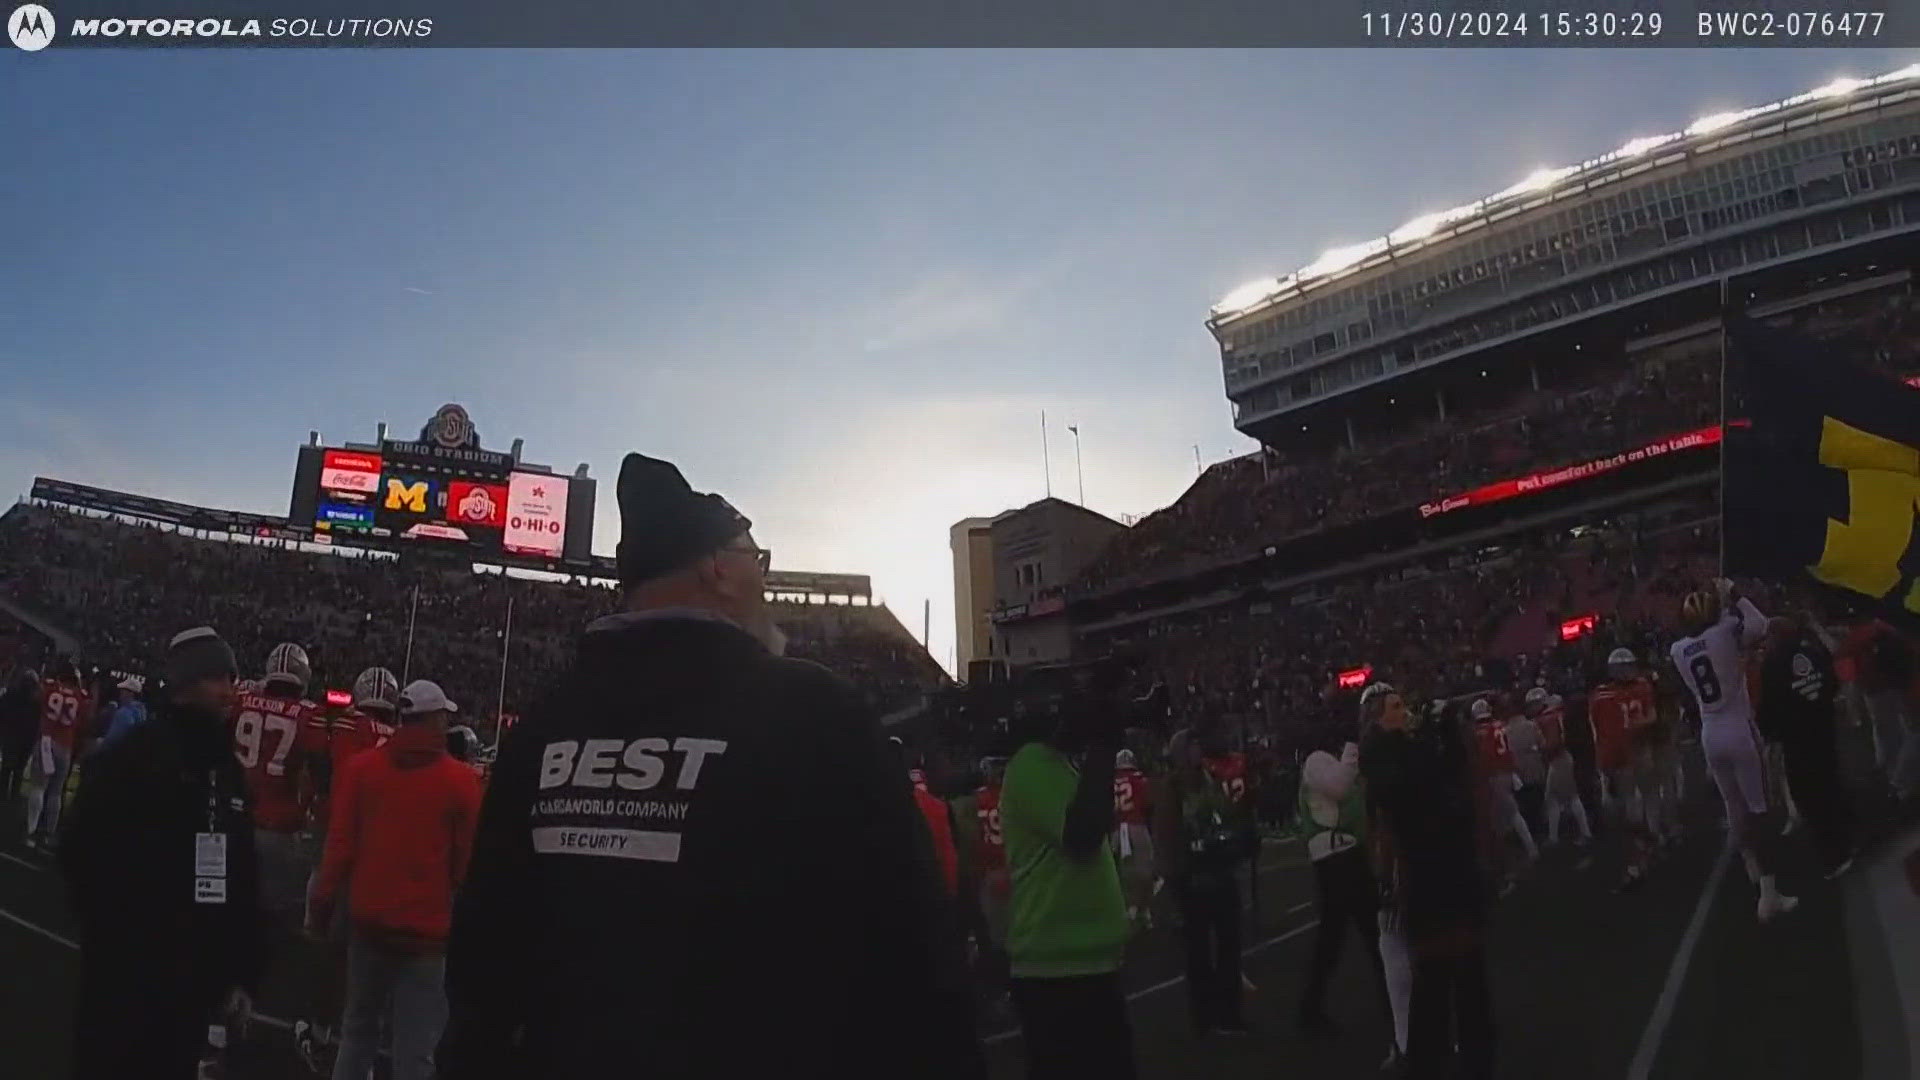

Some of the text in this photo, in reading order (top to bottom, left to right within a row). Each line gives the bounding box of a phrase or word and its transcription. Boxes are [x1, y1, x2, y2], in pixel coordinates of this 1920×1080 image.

[393, 441, 504, 465] OHIO STADIUM
[1517, 477, 1540, 493] Put
[1596, 453, 1627, 474] back
[1627, 448, 1645, 462] on
[1645, 442, 1668, 457] the
[384, 478, 429, 513] M
[1690, 655, 1722, 704] 8
[47, 692, 78, 726] 93
[241, 695, 285, 715] JACKSON
[234, 709, 298, 777] 97
[539, 736, 728, 790] BEST
[616, 801, 690, 821] COMPANY
[560, 832, 629, 850] SECURITY
